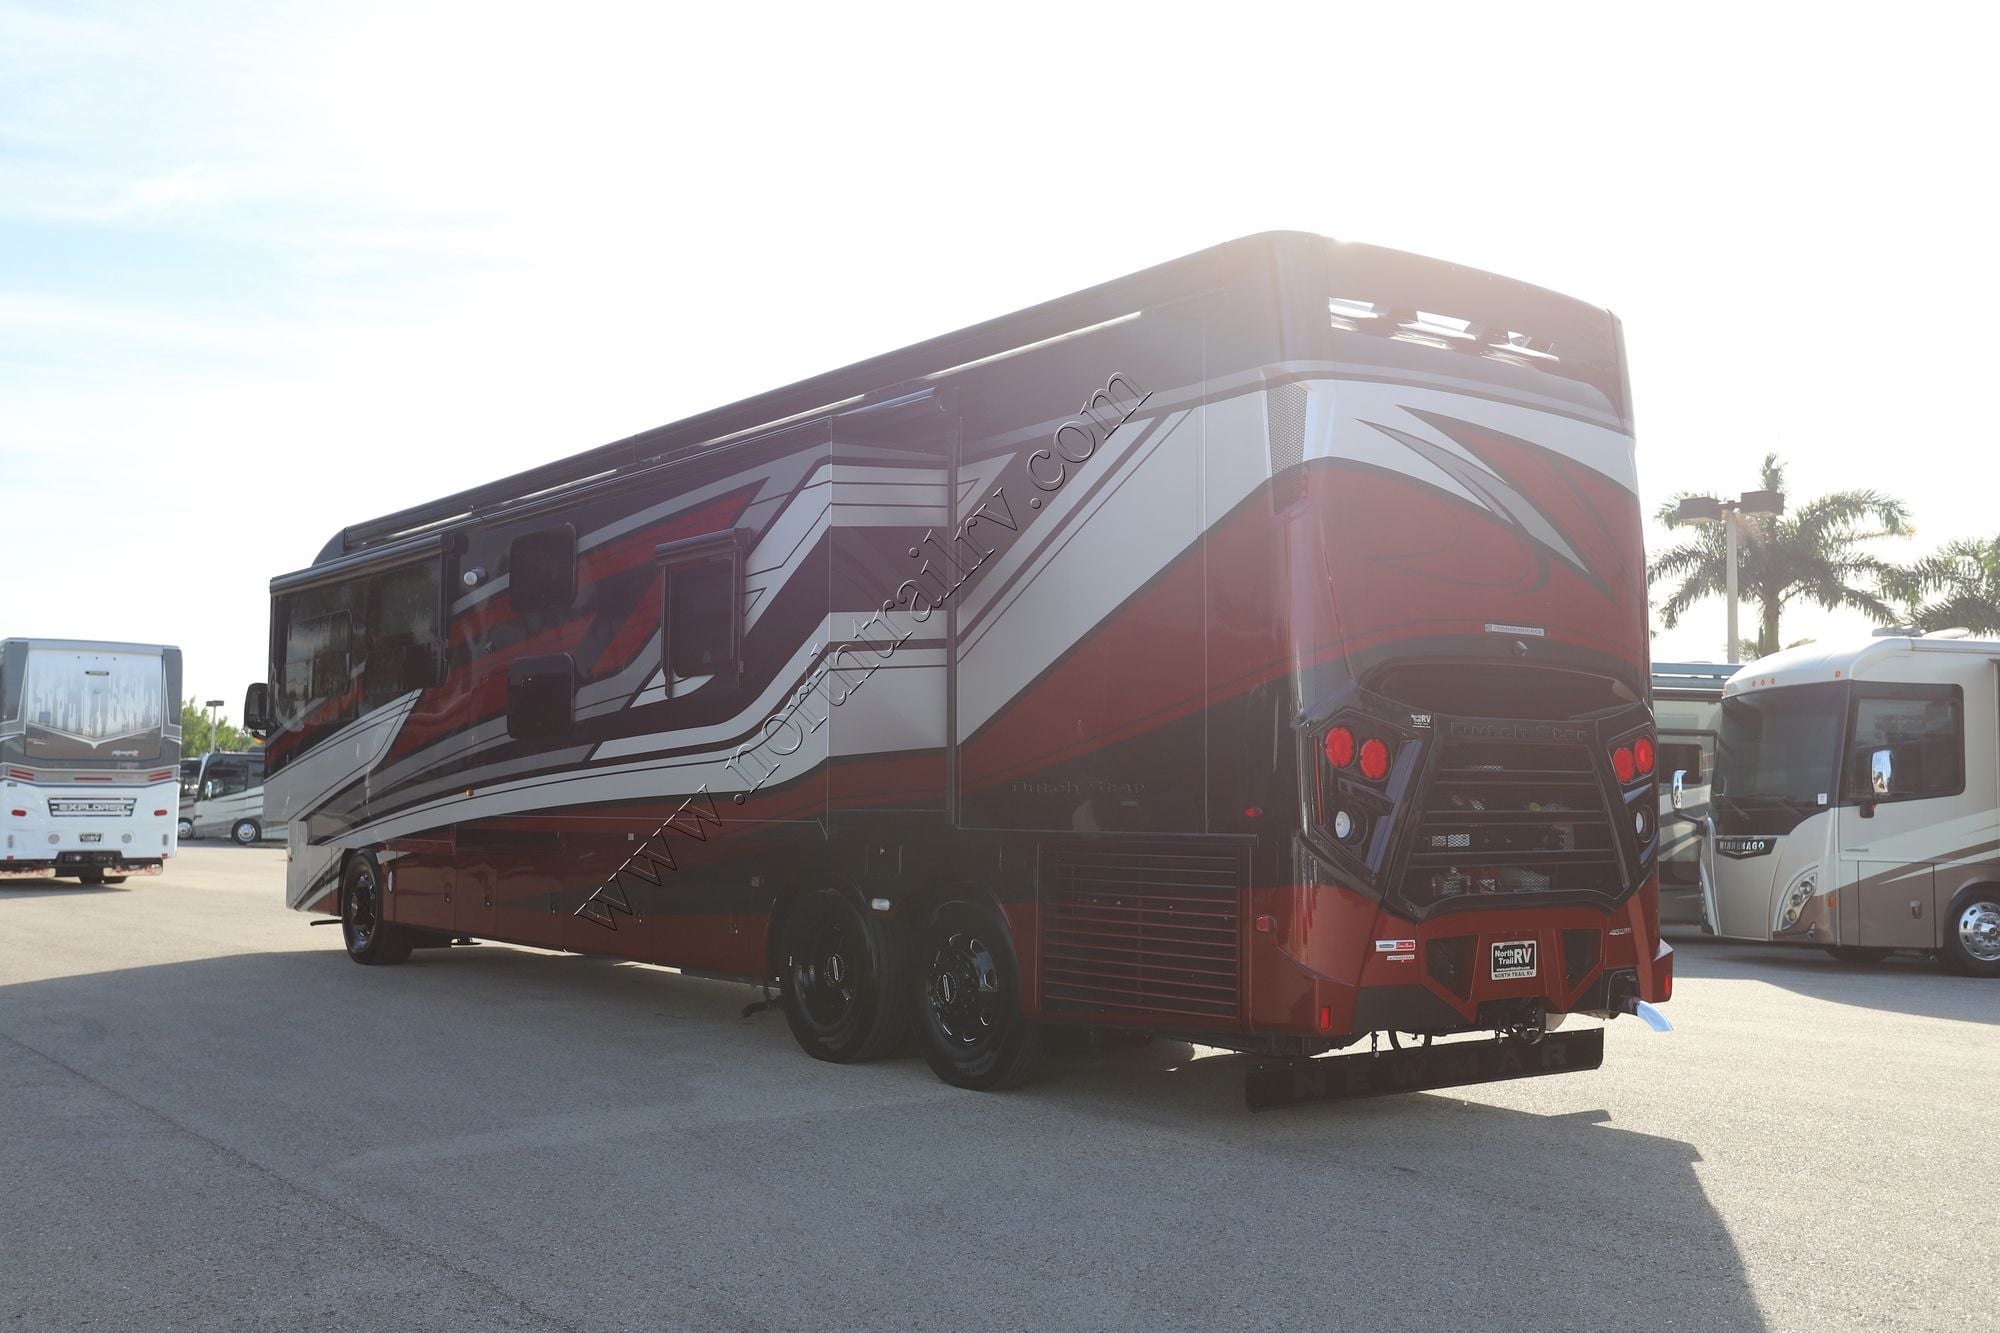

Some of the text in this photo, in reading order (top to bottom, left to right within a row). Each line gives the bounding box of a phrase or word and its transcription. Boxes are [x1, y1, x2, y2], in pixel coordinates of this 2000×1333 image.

[58, 803, 125, 811] EXPLORER
[1719, 841, 1765, 850] WINNEBAGO
[1494, 949, 1514, 958] North
[1514, 947, 1532, 964] RV
[1498, 956, 1514, 965] Trail
[1295, 1043, 1567, 1098] NEWMAR
